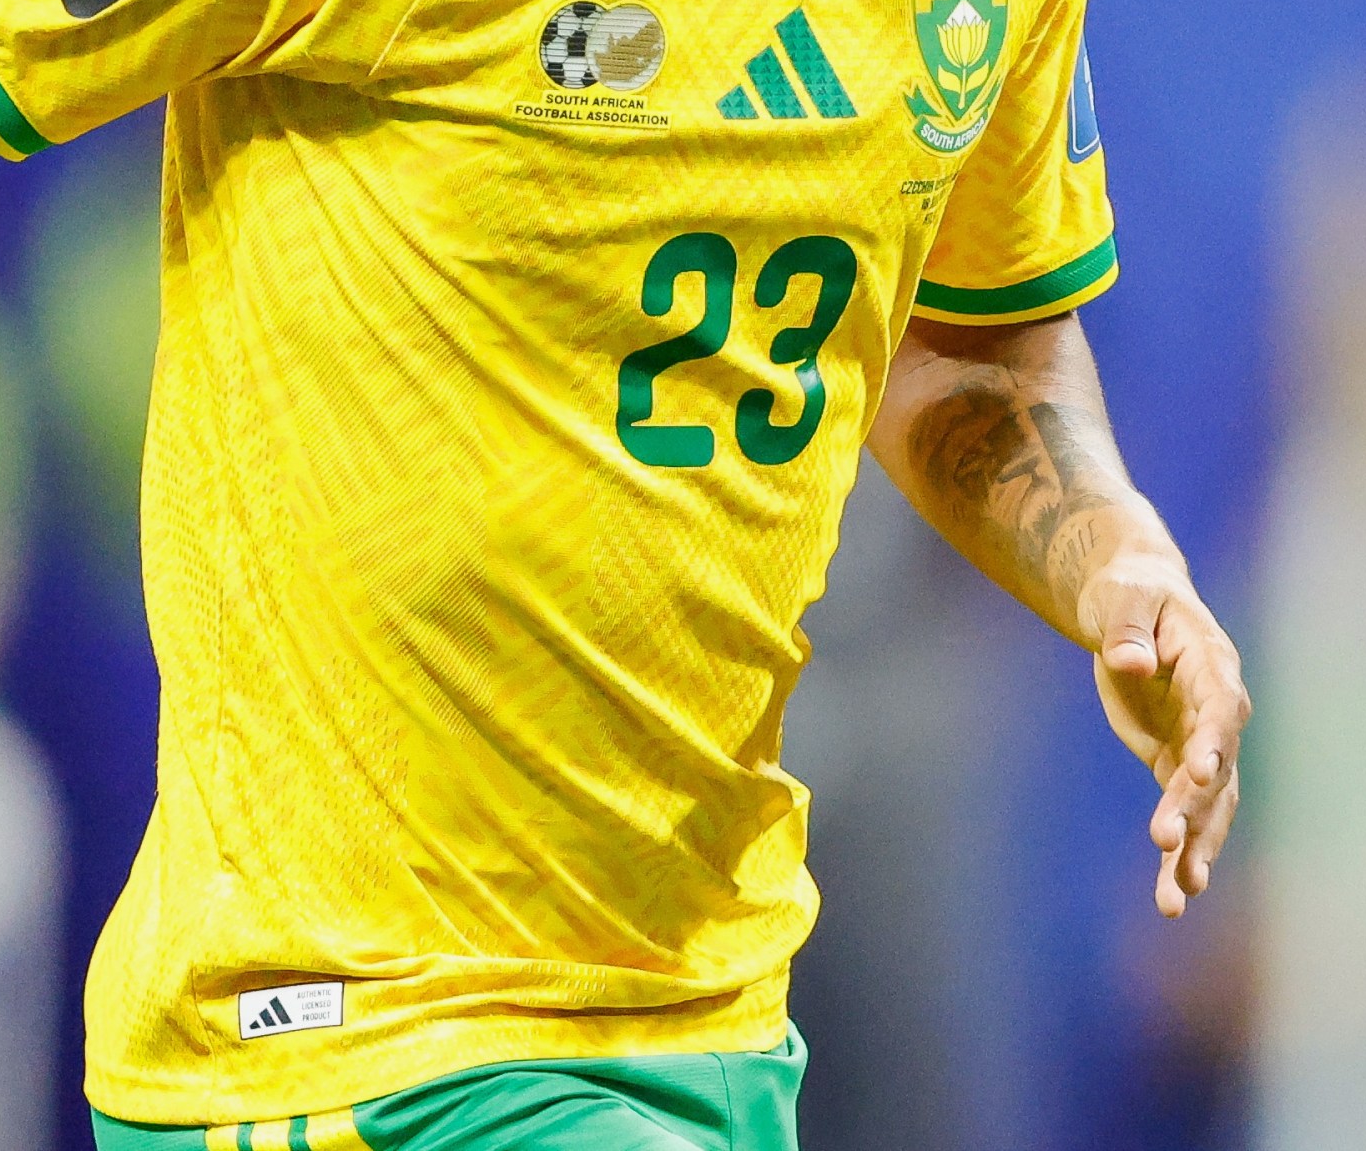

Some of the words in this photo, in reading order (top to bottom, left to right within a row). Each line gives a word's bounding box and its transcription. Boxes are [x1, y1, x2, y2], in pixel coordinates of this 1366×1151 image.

[546, 94, 588, 106] SOUTH
[592, 97, 644, 110] AFRICAN
[515, 105, 582, 120] FOOTBALL
[586, 112, 669, 126] ASSOCIATION
[920, 123, 954, 149] SOUTH
[954, 116, 985, 149] AFRICA
[616, 232, 858, 467] 23
[297, 988, 332, 999] AUTHENTIC
[302, 999, 332, 1010] LICENSED
[302, 1011, 331, 1022] PRODUCT
